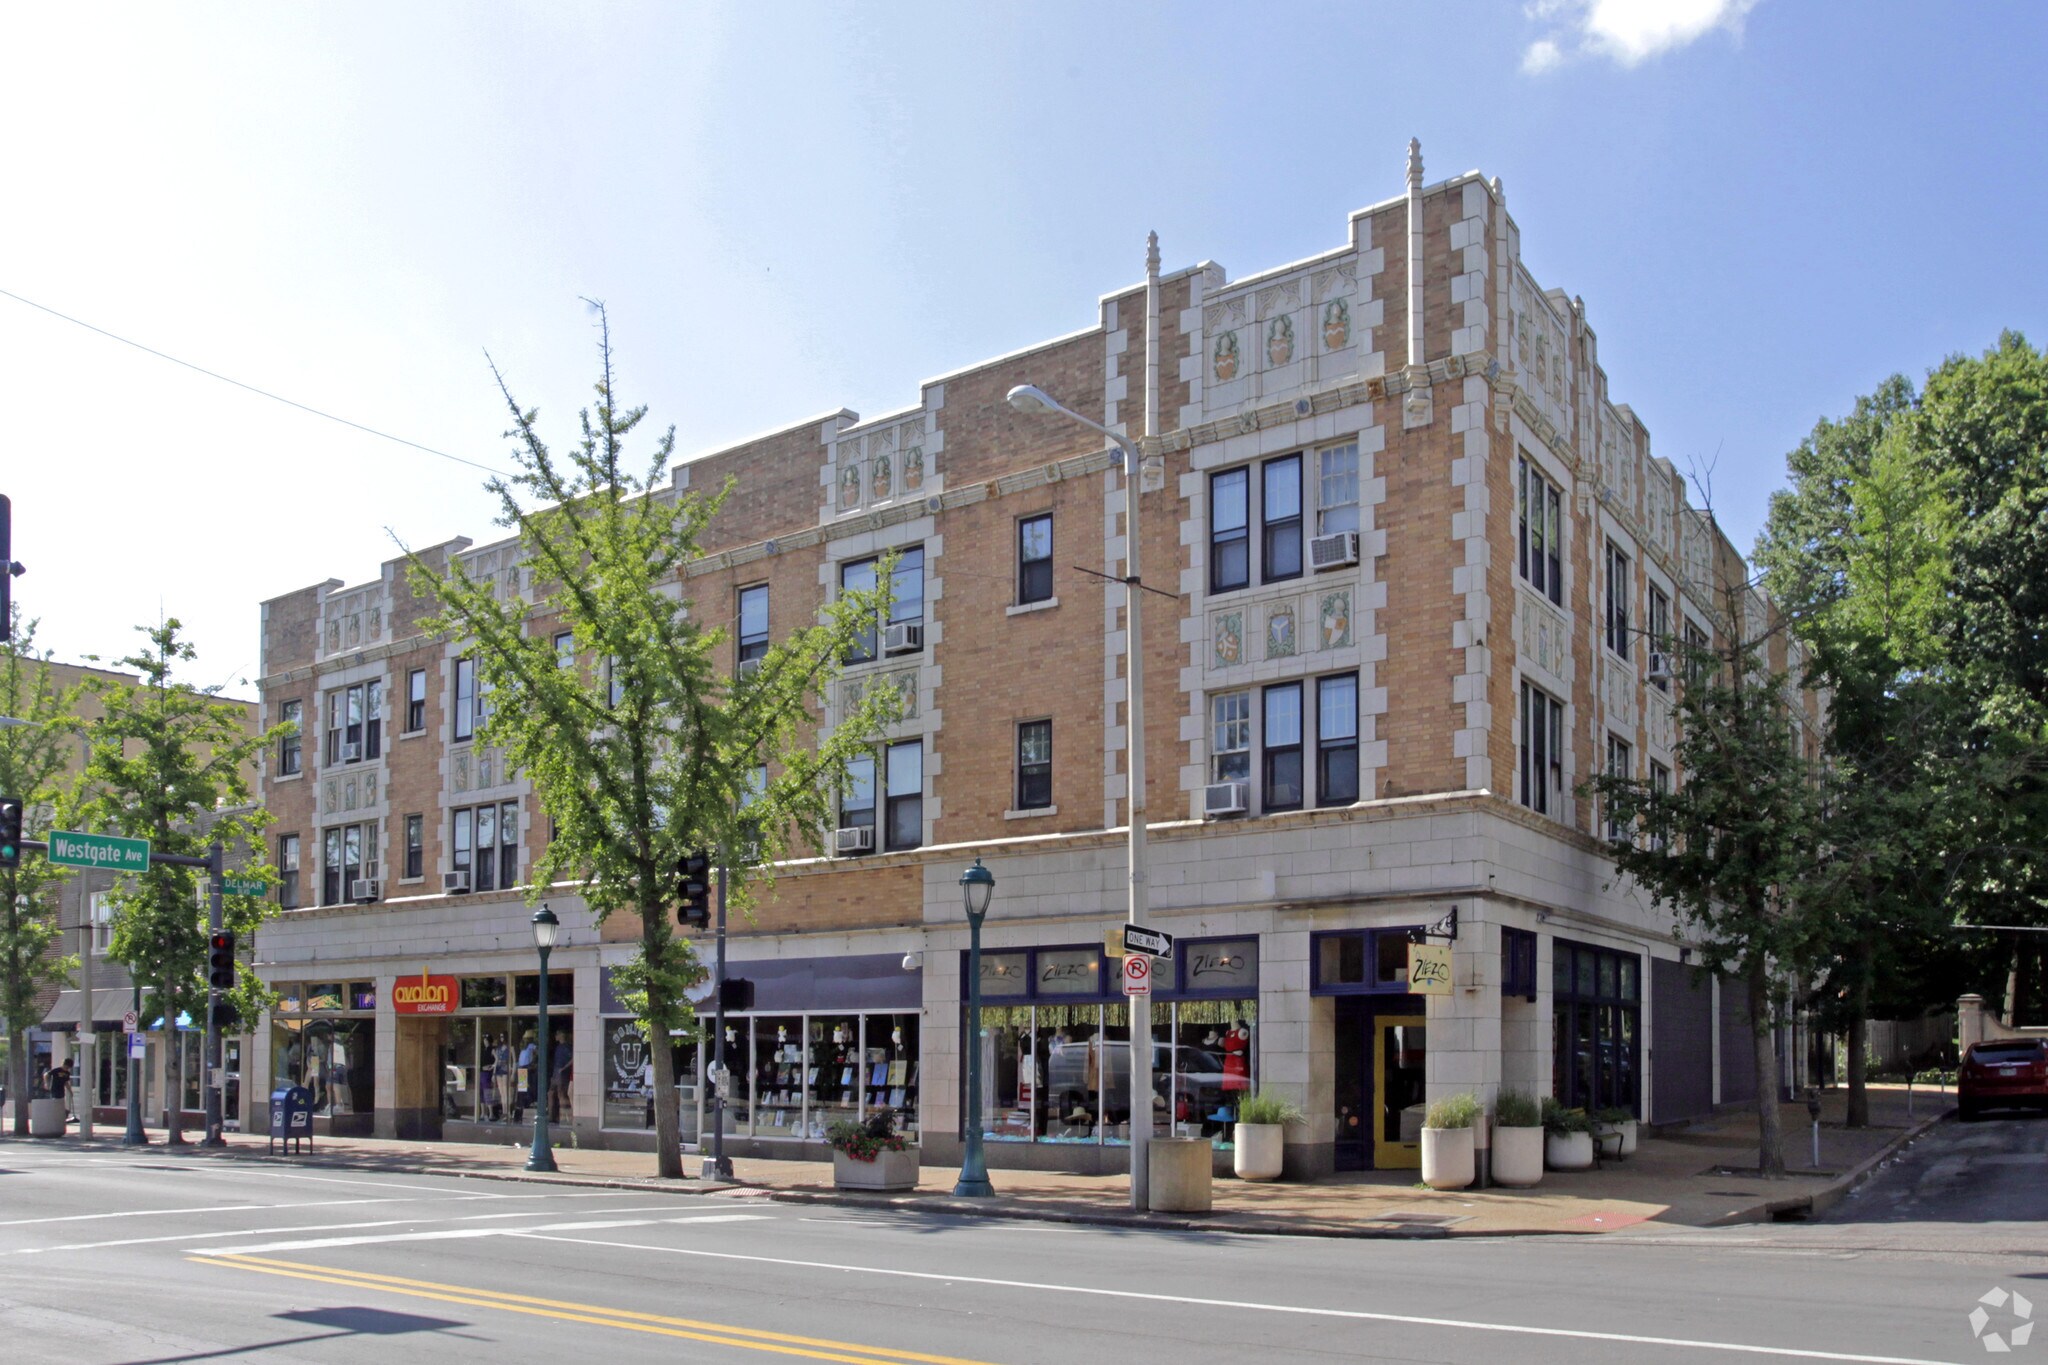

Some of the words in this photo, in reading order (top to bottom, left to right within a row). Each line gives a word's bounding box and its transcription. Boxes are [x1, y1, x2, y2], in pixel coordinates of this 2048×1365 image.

[55, 838, 121, 866] Westgate
[125, 848, 142, 862] Ave
[224, 878, 263, 890] DELMAR
[1129, 932, 1144, 945] ONE
[1145, 936, 1160, 949] WAY
[1412, 958, 1451, 984] ZIEZO
[394, 965, 449, 1003] avalon
[417, 1003, 447, 1012] EXCHANGE
